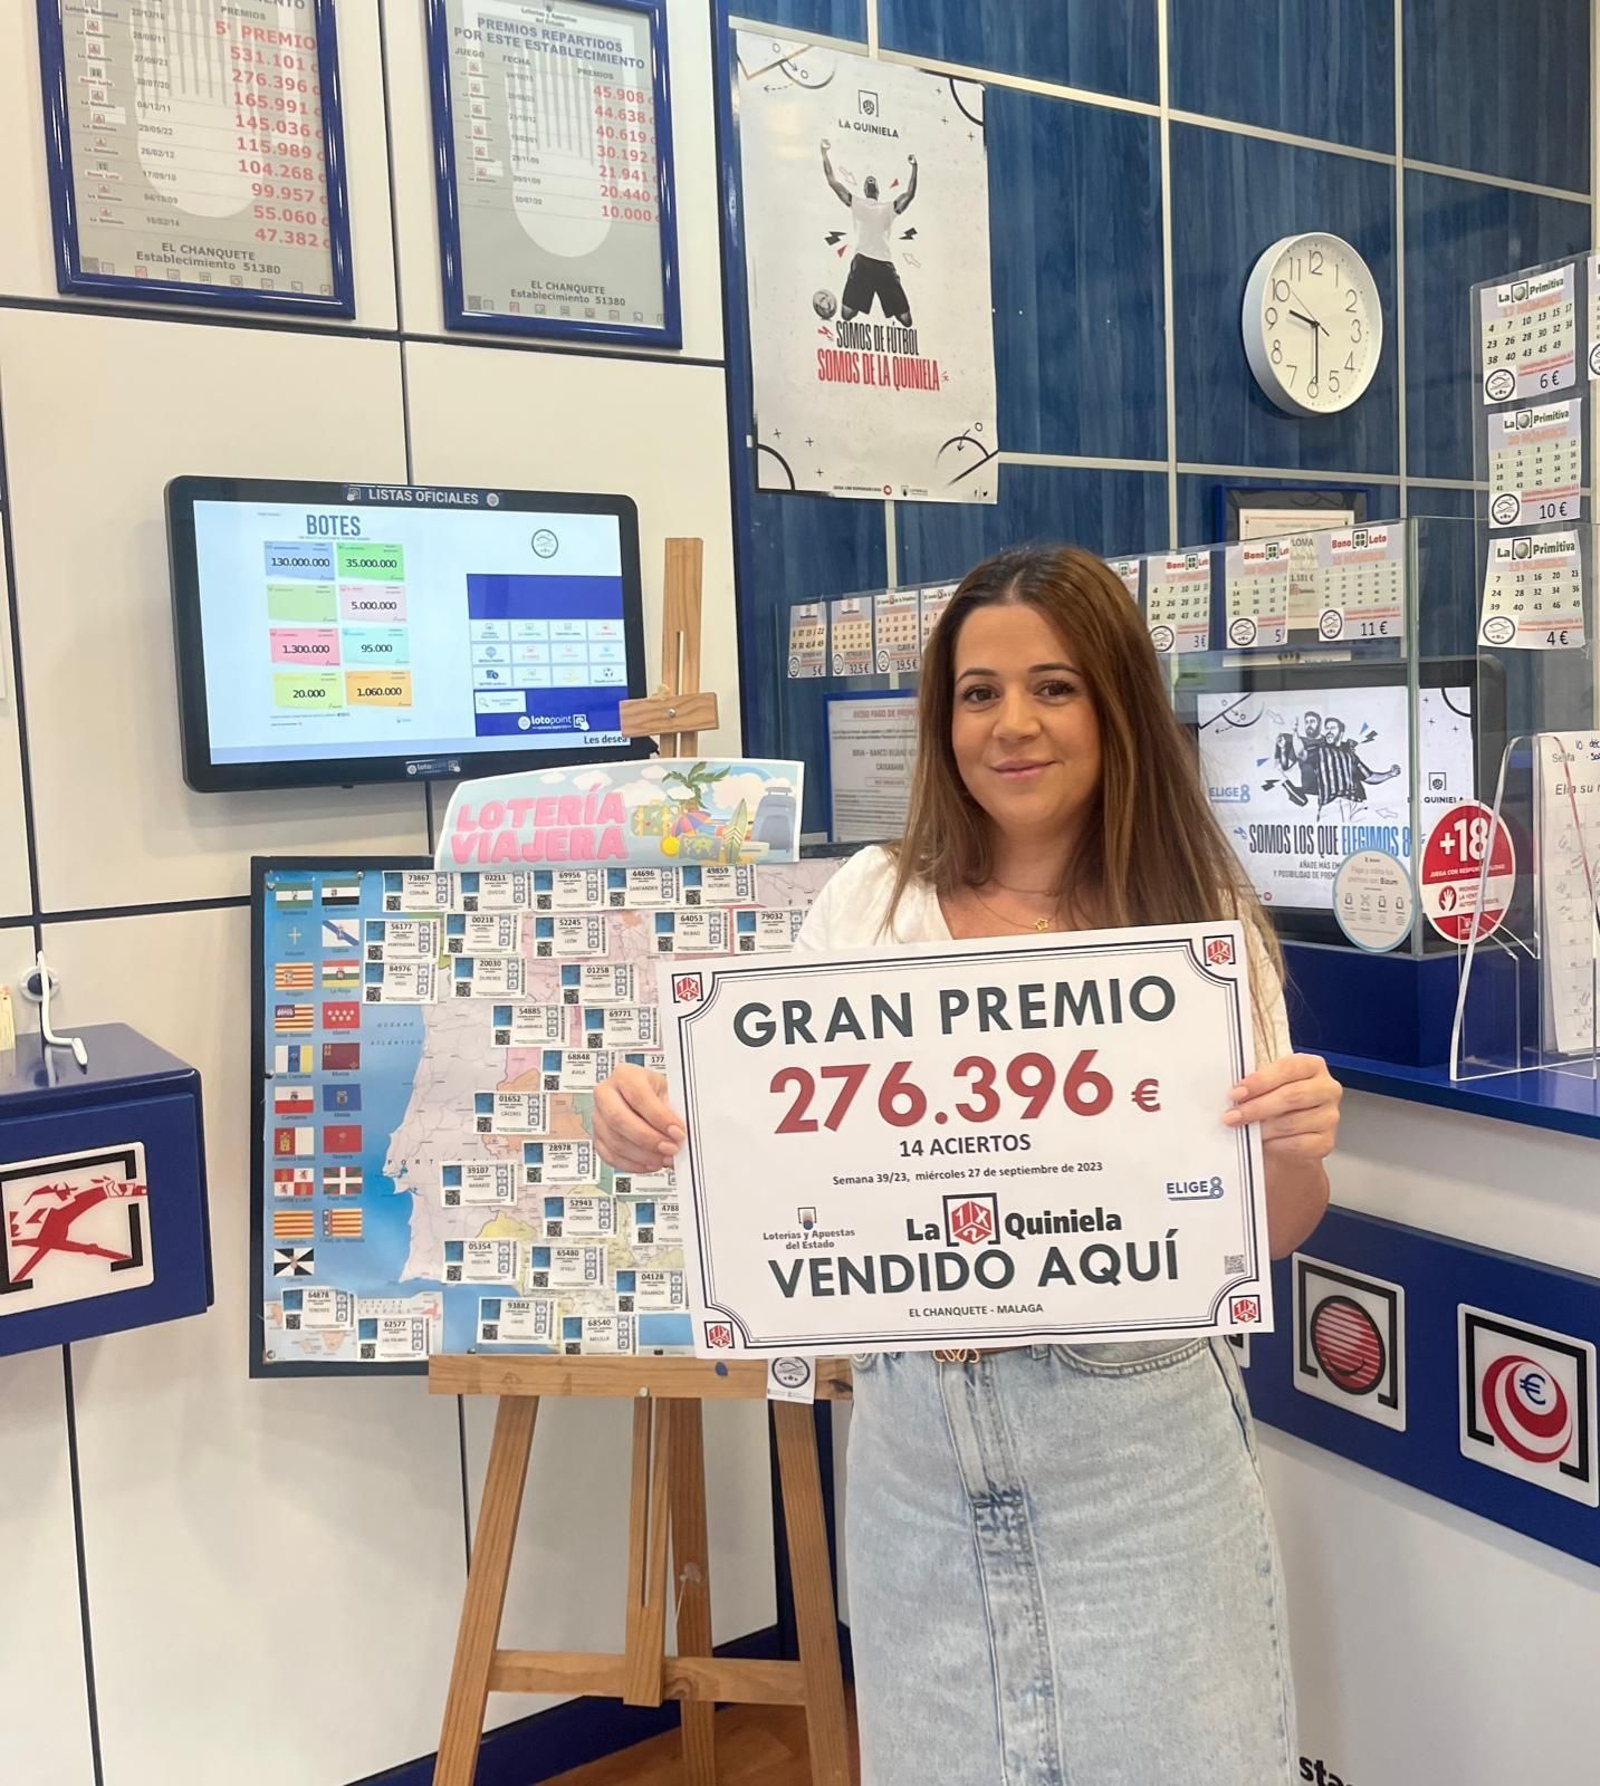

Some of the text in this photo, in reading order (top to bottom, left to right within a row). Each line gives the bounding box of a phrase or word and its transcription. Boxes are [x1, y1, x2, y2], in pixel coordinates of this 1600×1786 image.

[241, 24, 317, 51] PREMIO
[477, 17, 538, 39] PREMIOS
[541, 26, 624, 53] REPARTIDOS
[454, 26, 646, 70] POR ESTE ESTABLECIMIENTO
[230, 46, 306, 72] 531.101
[454, 47, 615, 81] JUEGO FECHA PREMIOS
[232, 69, 308, 94] 276.396
[234, 91, 309, 117] 165.991
[593, 85, 645, 105] 45.908
[594, 105, 646, 125] 44.638
[235, 114, 311, 140] 145.036
[596, 125, 648, 145] 40.619
[838, 119, 900, 138] LA QUINIELA
[237, 136, 313, 162] 115.989
[597, 145, 649, 163] 30.192
[238, 159, 314, 184] 104.268
[598, 165, 649, 184] 21.941
[251, 182, 315, 204] 99.957
[600, 185, 651, 203] 20.440
[253, 205, 317, 227] 55.060
[601, 205, 652, 223] 10.000
[255, 228, 319, 249] 47.382
[161, 242, 256, 262] EL CHANQUETE
[136, 250, 281, 276] Establecimiento 51380
[1289, 257, 1301, 282] 11
[1309, 250, 1324, 276] 12
[510, 289, 626, 307] Establecimiento 51380
[531, 281, 606, 296] EL CHANQUETE
[1272, 278, 1291, 303] 10
[1498, 278, 1565, 303] La Primitiva
[1345, 289, 1358, 313] 2
[1265, 307, 1278, 331] 9
[836, 321, 920, 356] SOMOS DE FÚTBOL
[1351, 319, 1362, 344] 3
[1271, 339, 1283, 365] 8
[1344, 352, 1356, 371] 4
[817, 348, 941, 392] SOMOS DE LA QUINIELA
[1286, 364, 1298, 388] 7
[1540, 370, 1560, 389] 6 €
[1307, 375, 1319, 399] 6
[1328, 370, 1340, 393] 5
[1504, 410, 1569, 429] La Primitiva
[368, 489, 479, 505] LISTAS OFICIALES
[1540, 501, 1568, 519] 10 €
[306, 514, 361, 537] BOTES
[1332, 534, 1387, 550] Bono Loto
[1497, 540, 1575, 558] La Primitiva
[271, 557, 330, 568] 130.000.000
[345, 558, 397, 568] 35.000.000
[351, 600, 397, 611] 5.000.000
[1360, 621, 1388, 637] 11 €
[1546, 630, 1569, 646] 4 €
[282, 644, 330, 654] 1.300.000
[361, 644, 393, 653] 95.000
[292, 689, 326, 699] 20.000
[356, 687, 402, 697] 1.060.000
[531, 714, 572, 727] lotopoint
[584, 734, 628, 745] Les desea
[456, 783, 626, 832] LOTERÍA
[450, 827, 629, 865] VIAJERA
[1249, 824, 1291, 855] SOMOS
[1294, 824, 1315, 855] LOS
[1317, 825, 1339, 859] QUE
[1402, 825, 1411, 858] 8
[1440, 817, 1489, 862] +18
[408, 874, 430, 882] 73867
[558, 871, 581, 879] 69956
[471, 916, 494, 924] 00218
[680, 914, 703, 922] 64053
[761, 912, 784, 920] 79032
[390, 923, 412, 931] 56177
[389, 965, 411, 973] 84976
[479, 959, 501, 967] 20030
[519, 1007, 541, 1015] 54885
[609, 1010, 632, 1018] 69771
[732, 975, 1176, 1049] GRAN PREMIO
[499, 1095, 521, 1103] 01652
[769, 1049, 1161, 1135] 276.396 €
[899, 1133, 1032, 1158] 14 ACIERTOS
[466, 1166, 489, 1174] 39107
[833, 1161, 1104, 1186] Semana 39/23, miércoles 27 de septiembre de 2023
[570, 1199, 592, 1207] 52943
[906, 1218, 940, 1242] La
[1004, 1206, 1123, 1238] Quiniela
[763, 1227, 856, 1242] Loterías y Apuestas
[468, 1242, 491, 1251] 05354
[556, 1249, 580, 1257] 65480
[785, 1239, 836, 1250] del Estado
[768, 1228, 1180, 1299] VENDIDO AQUÍ
[641, 1272, 664, 1281] 04128
[507, 1302, 530, 1311] 93882
[908, 1303, 1044, 1318] EL CHANQUETE MALAGA
[384, 1320, 406, 1328] 62577
[587, 1318, 612, 1327] 68540
